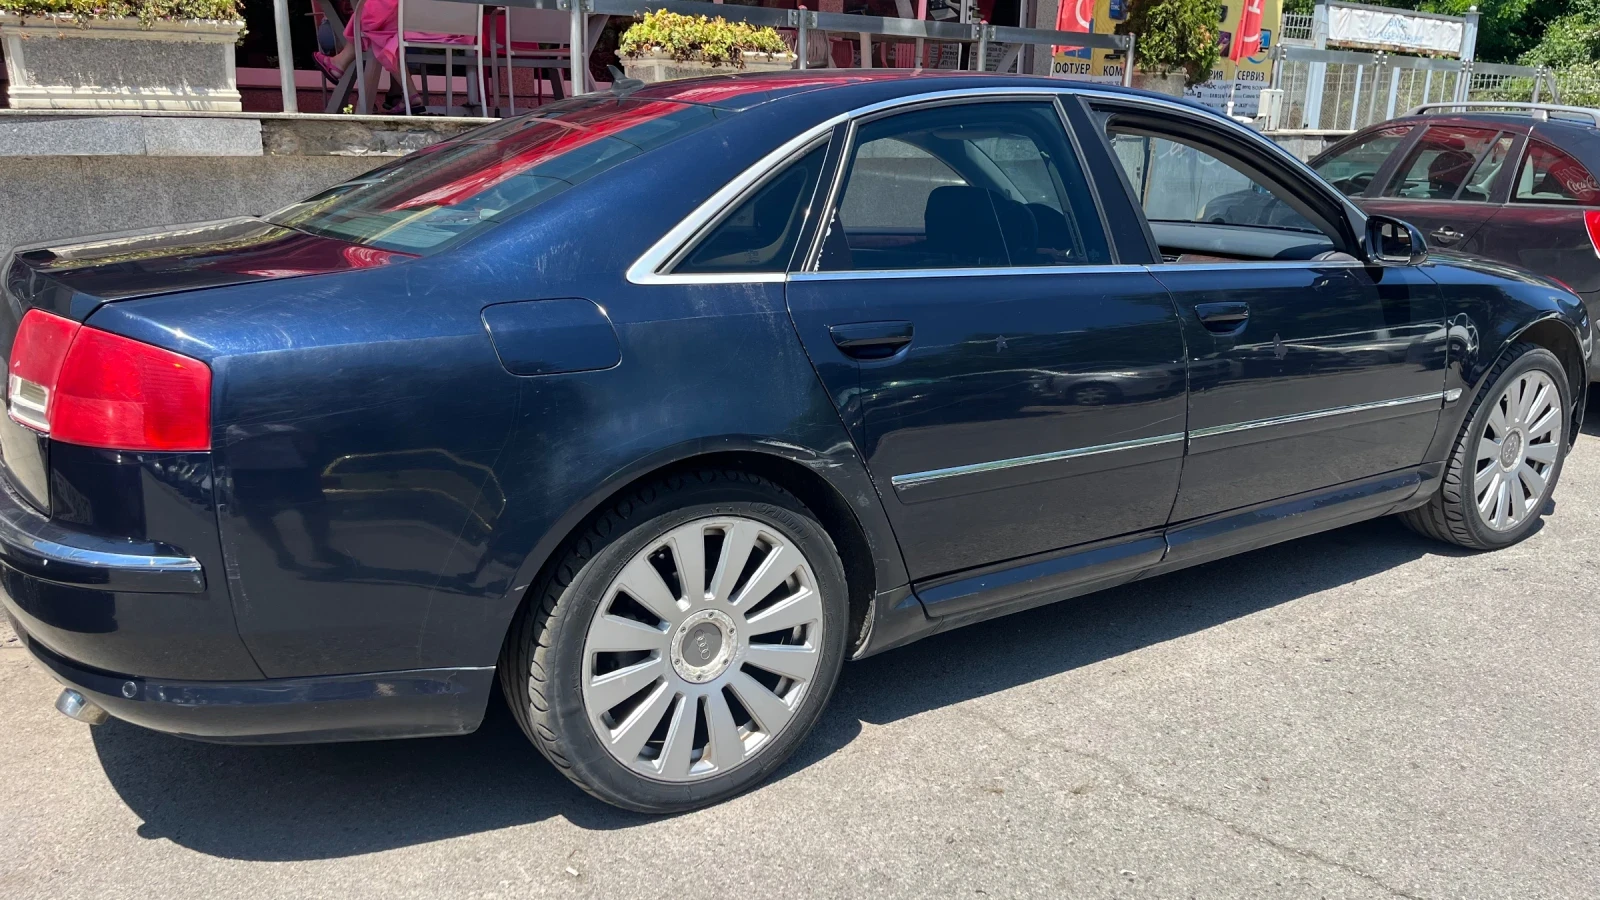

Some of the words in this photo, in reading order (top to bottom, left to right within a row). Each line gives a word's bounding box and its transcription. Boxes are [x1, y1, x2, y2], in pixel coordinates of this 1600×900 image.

[1053, 62, 1091, 74] ОФТУЕР
[1103, 65, 1122, 77] КОМ
[1237, 70, 1265, 82] СЕРВИЗ
